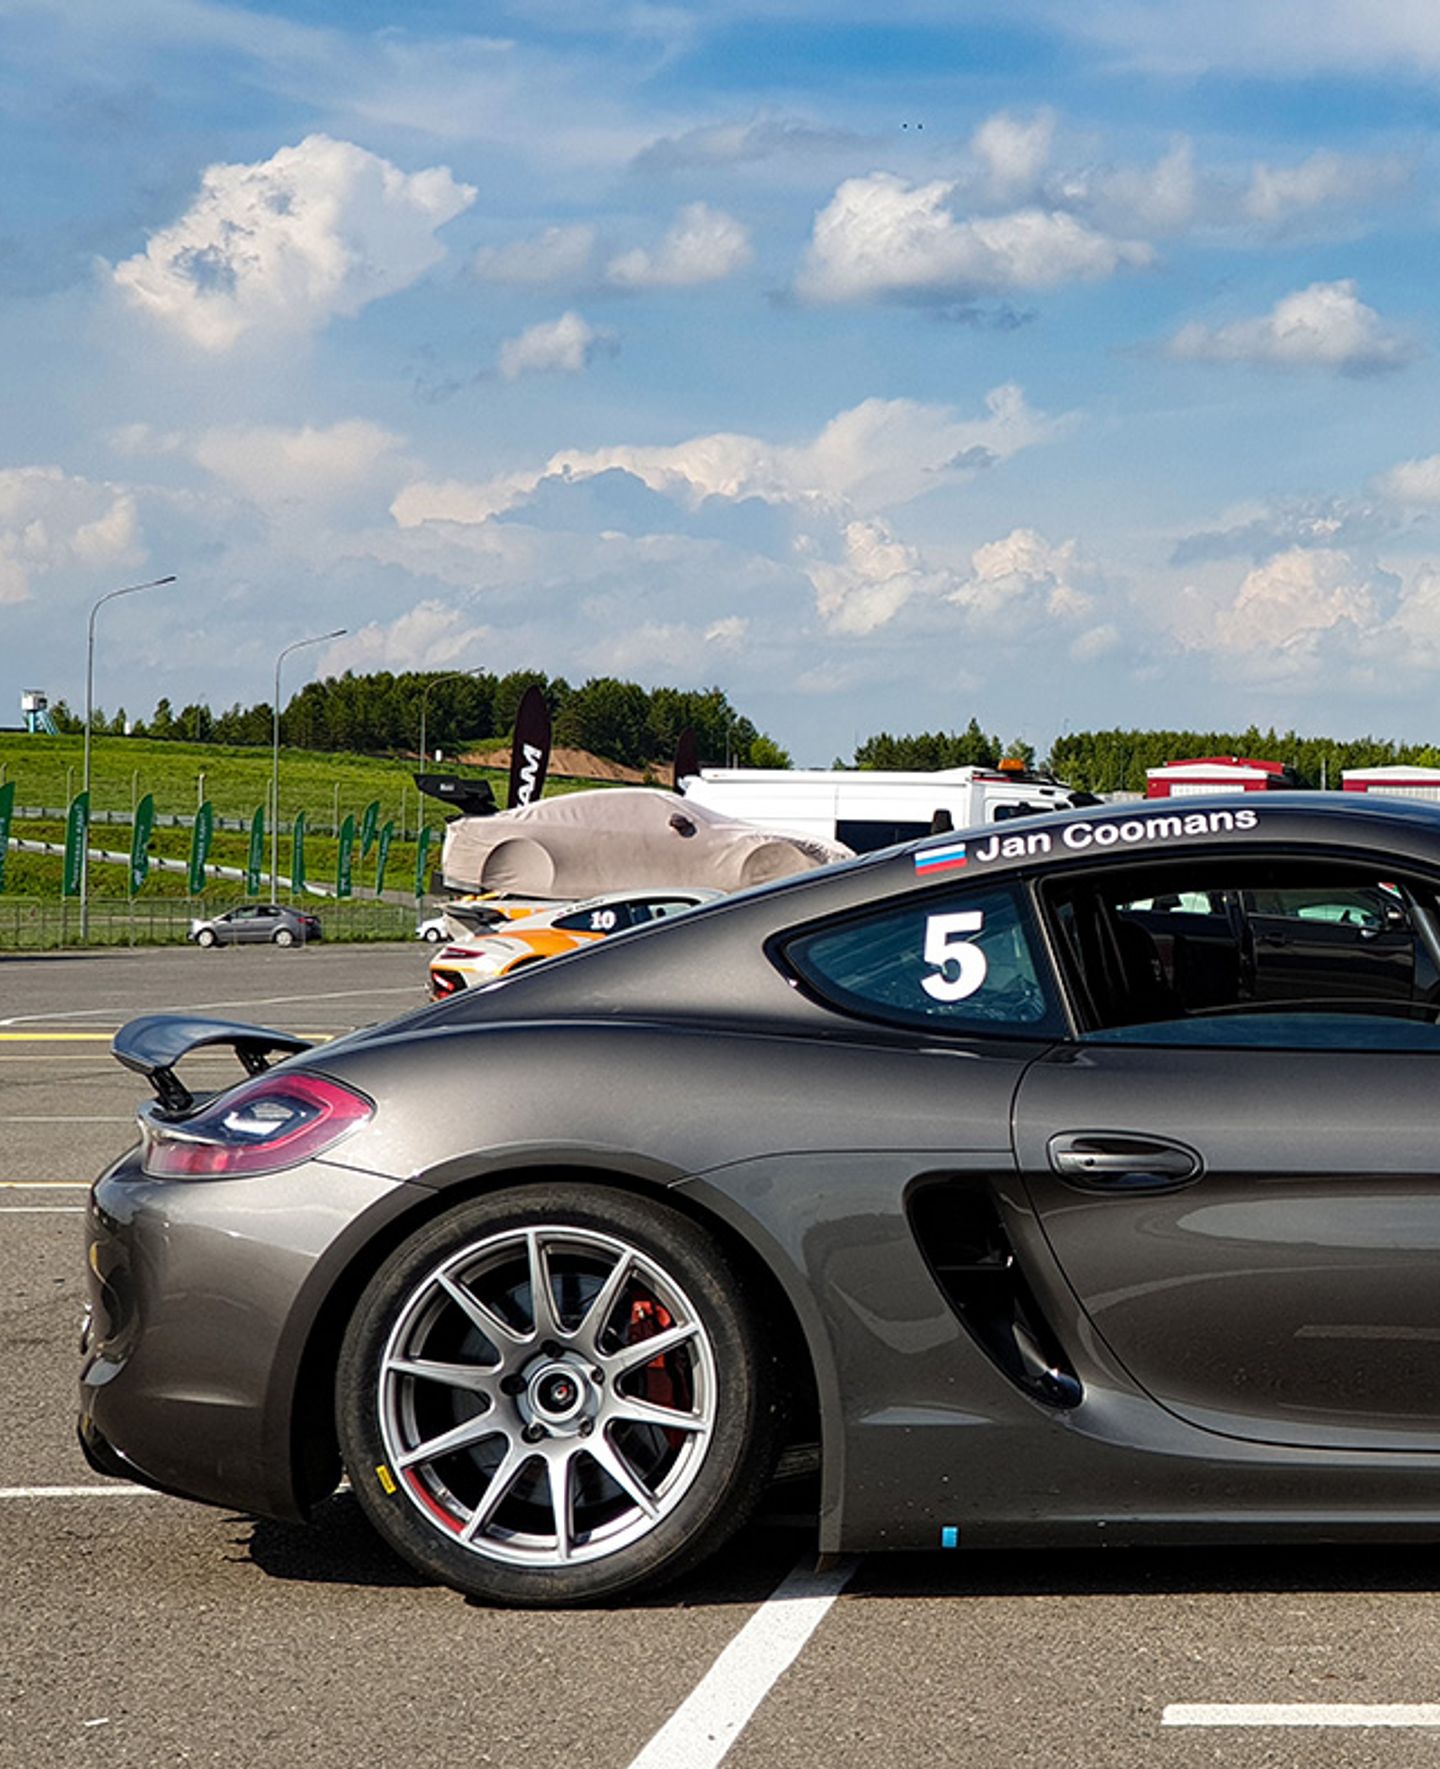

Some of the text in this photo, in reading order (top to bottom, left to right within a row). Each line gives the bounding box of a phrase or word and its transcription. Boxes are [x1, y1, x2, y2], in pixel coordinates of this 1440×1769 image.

[976, 808, 1258, 862] Jan Coomans
[590, 909, 617, 931] 10
[920, 911, 987, 1002] 5
